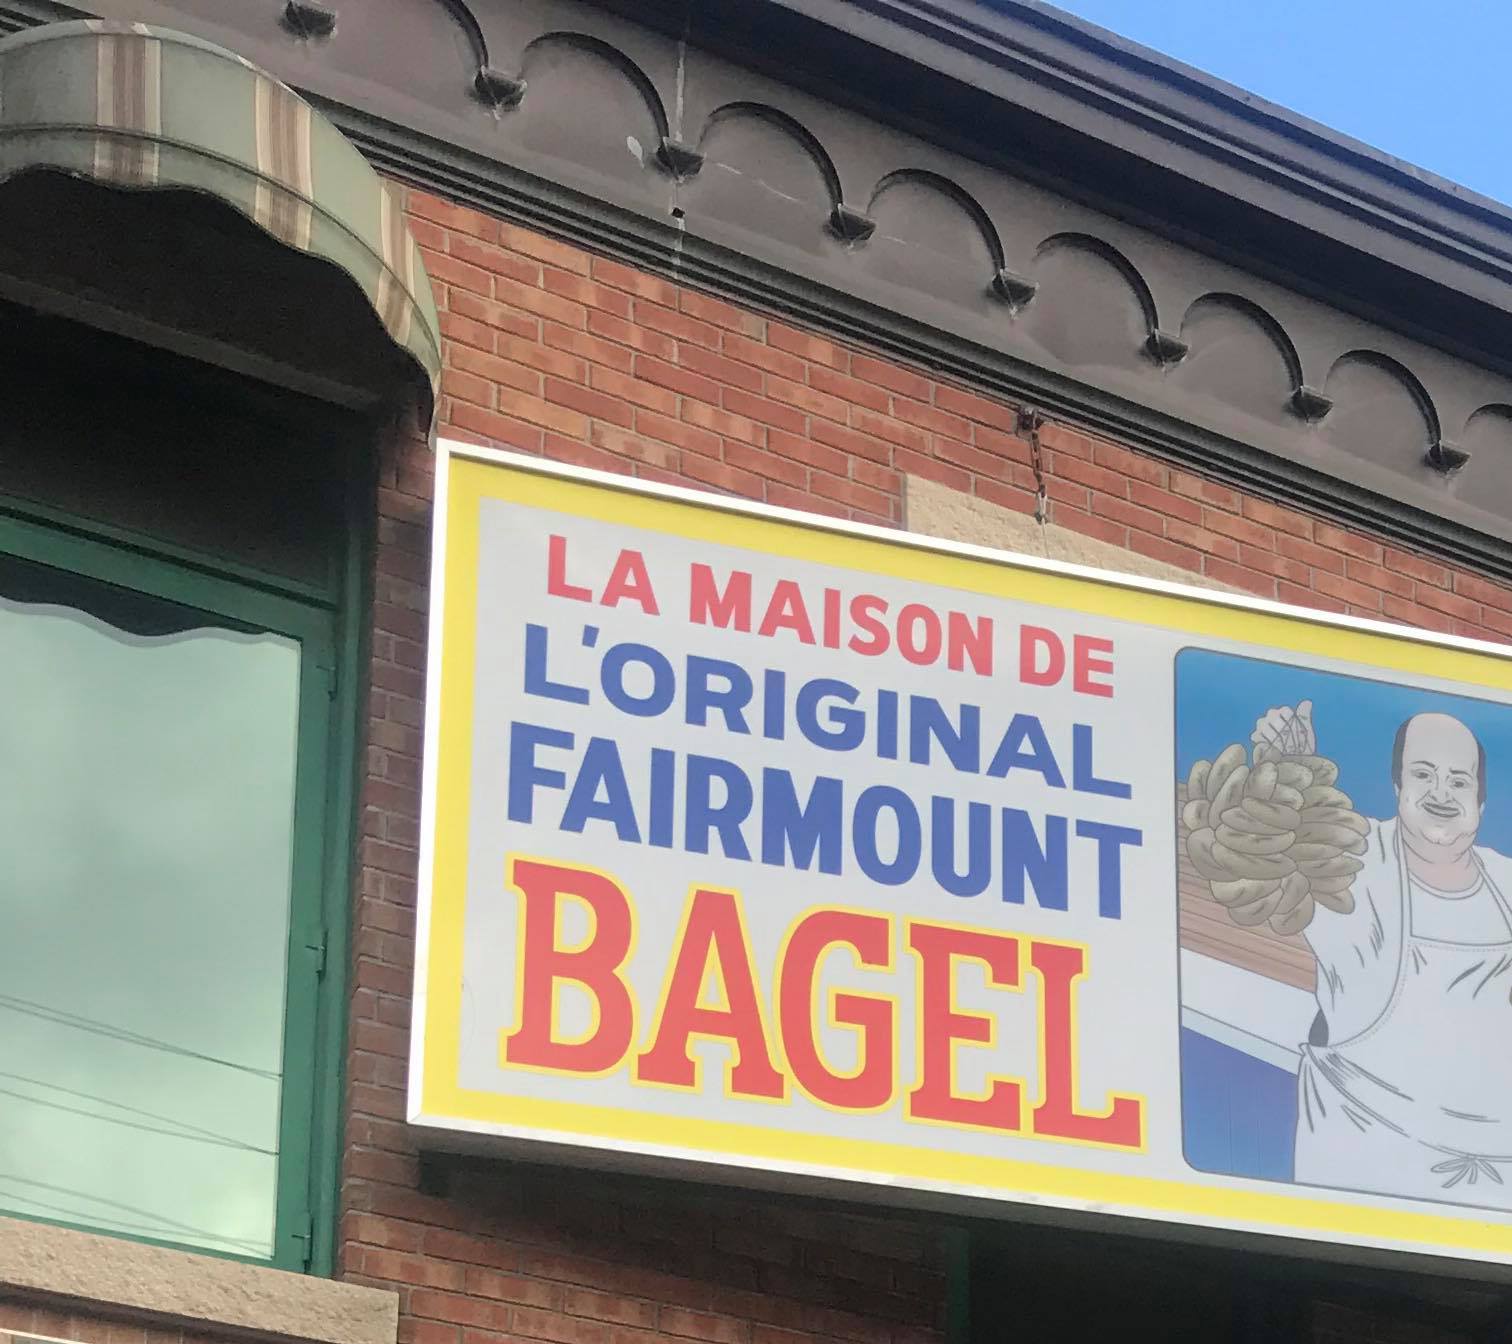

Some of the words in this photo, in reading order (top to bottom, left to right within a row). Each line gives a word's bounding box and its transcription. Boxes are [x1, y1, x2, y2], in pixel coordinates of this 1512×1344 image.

[546, 534, 659, 617] LA
[688, 562, 994, 678] MAISON
[1018, 624, 1115, 699] DE
[522, 622, 1132, 800] L'ORIGINAL
[507, 721, 1144, 920] FAIRMOUNT
[503, 857, 1145, 1149] BAGEL
